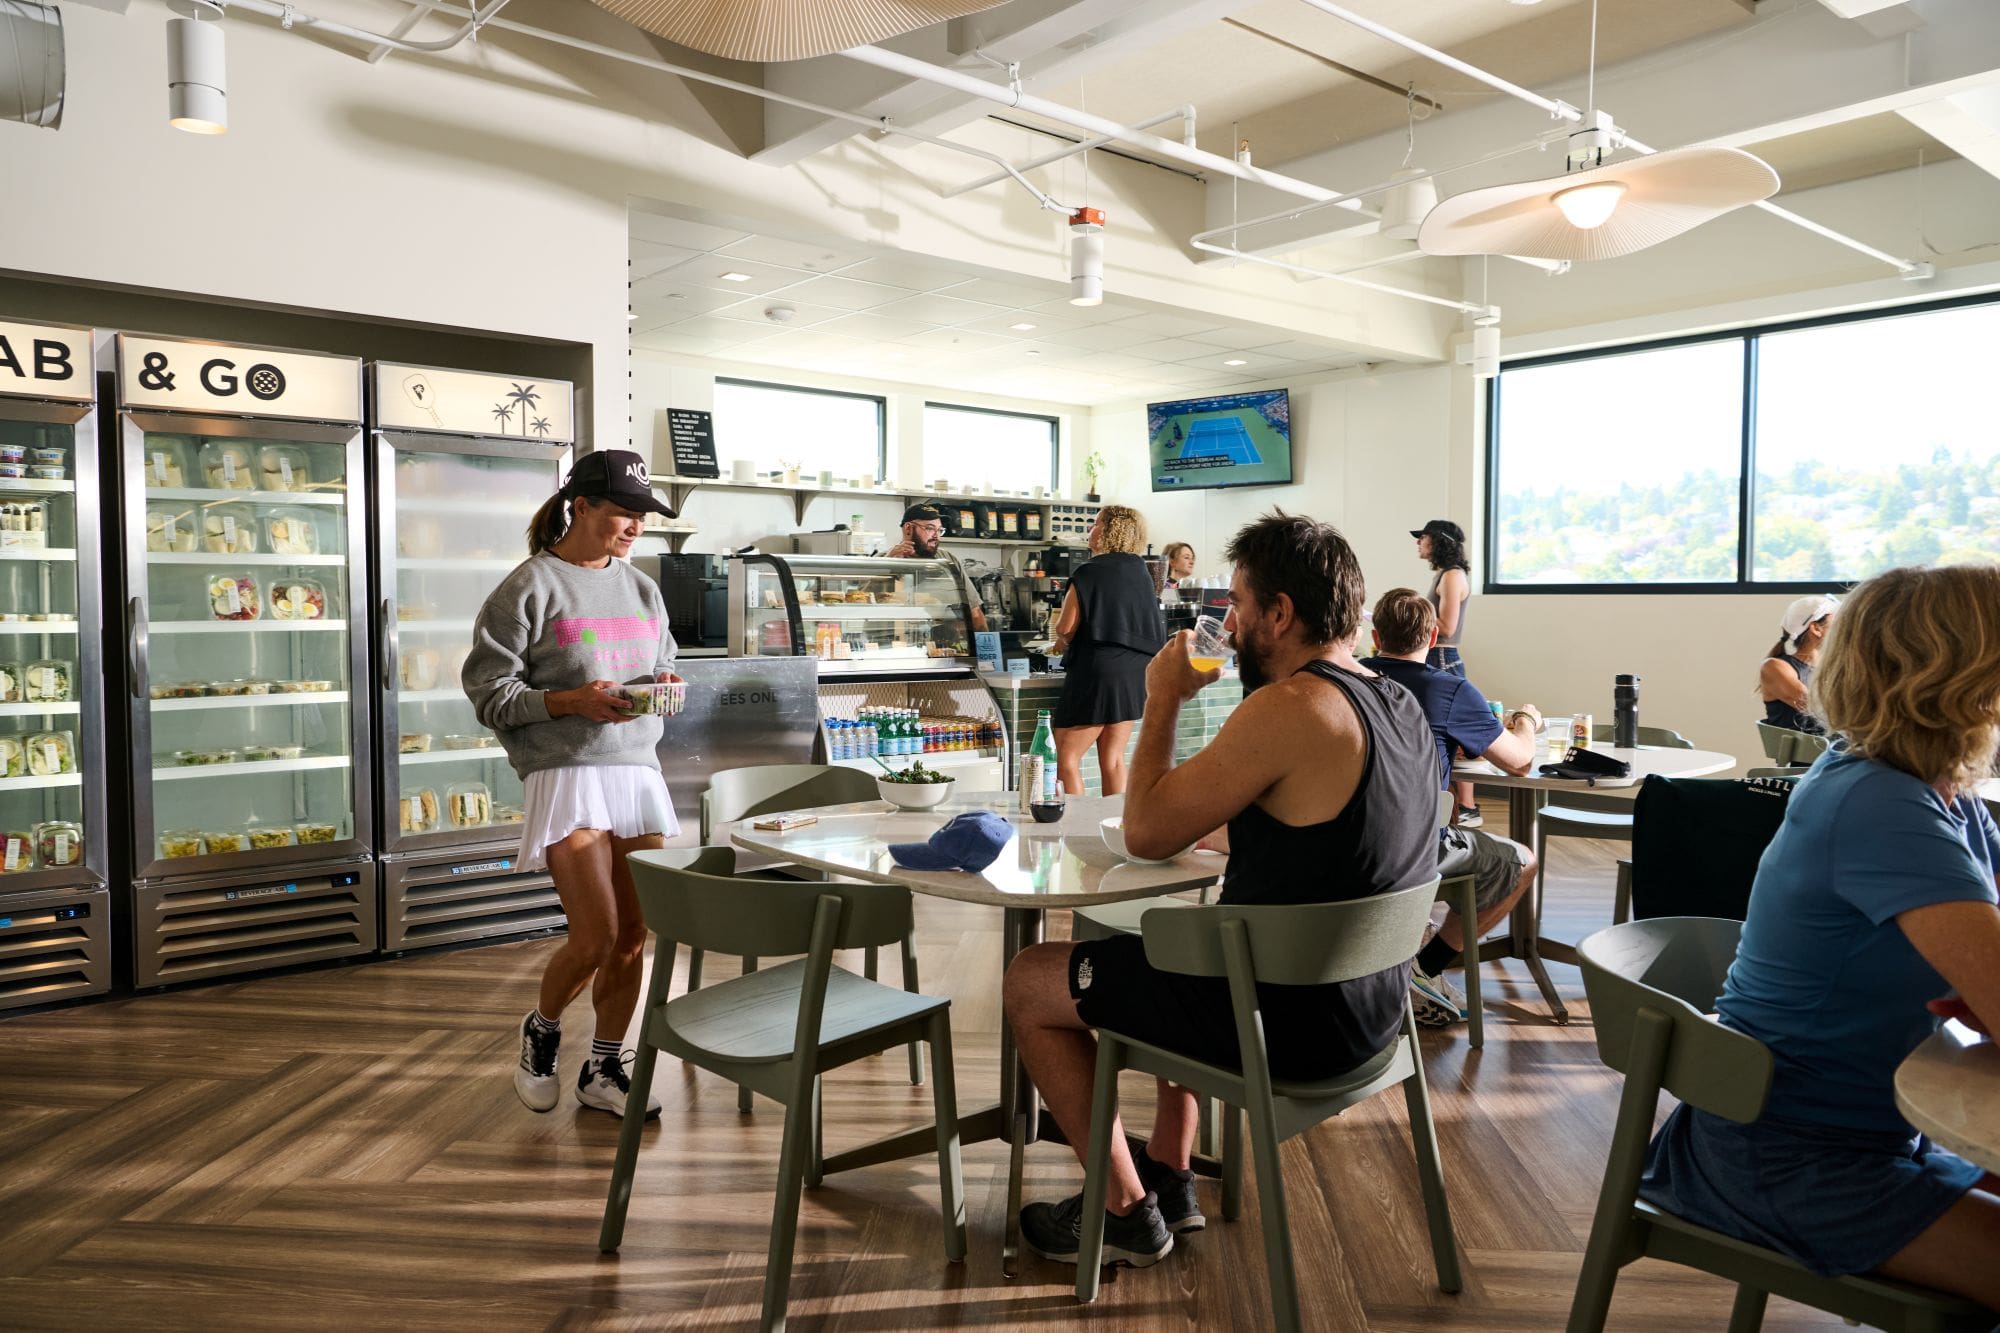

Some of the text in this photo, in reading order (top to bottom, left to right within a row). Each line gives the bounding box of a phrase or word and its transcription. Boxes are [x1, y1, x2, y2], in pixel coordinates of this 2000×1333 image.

[138, 351, 176, 392] &
[199, 358, 286, 400] GO
[1734, 777, 1793, 791] EATTL
